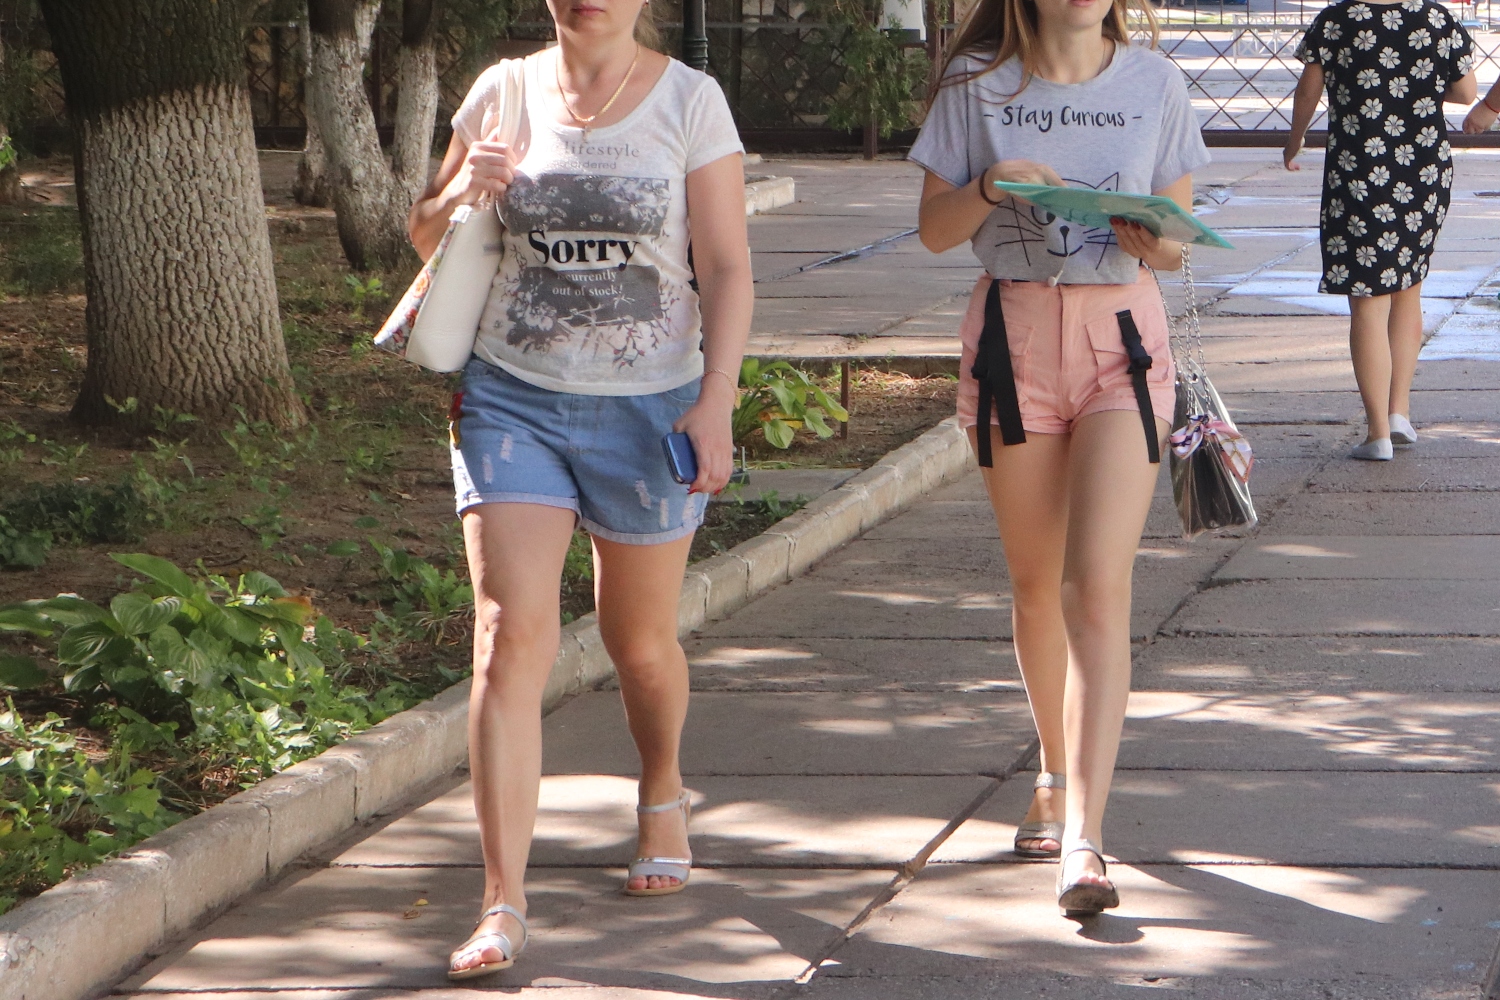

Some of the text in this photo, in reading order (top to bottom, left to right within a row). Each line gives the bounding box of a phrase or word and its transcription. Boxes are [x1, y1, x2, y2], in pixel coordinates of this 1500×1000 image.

[1001, 104, 1125, 132] Stay Curious
[564, 141, 640, 160] lifestyle
[528, 229, 641, 272] Sorry
[565, 269, 617, 282] currently
[552, 283, 623, 296] out of stock!
